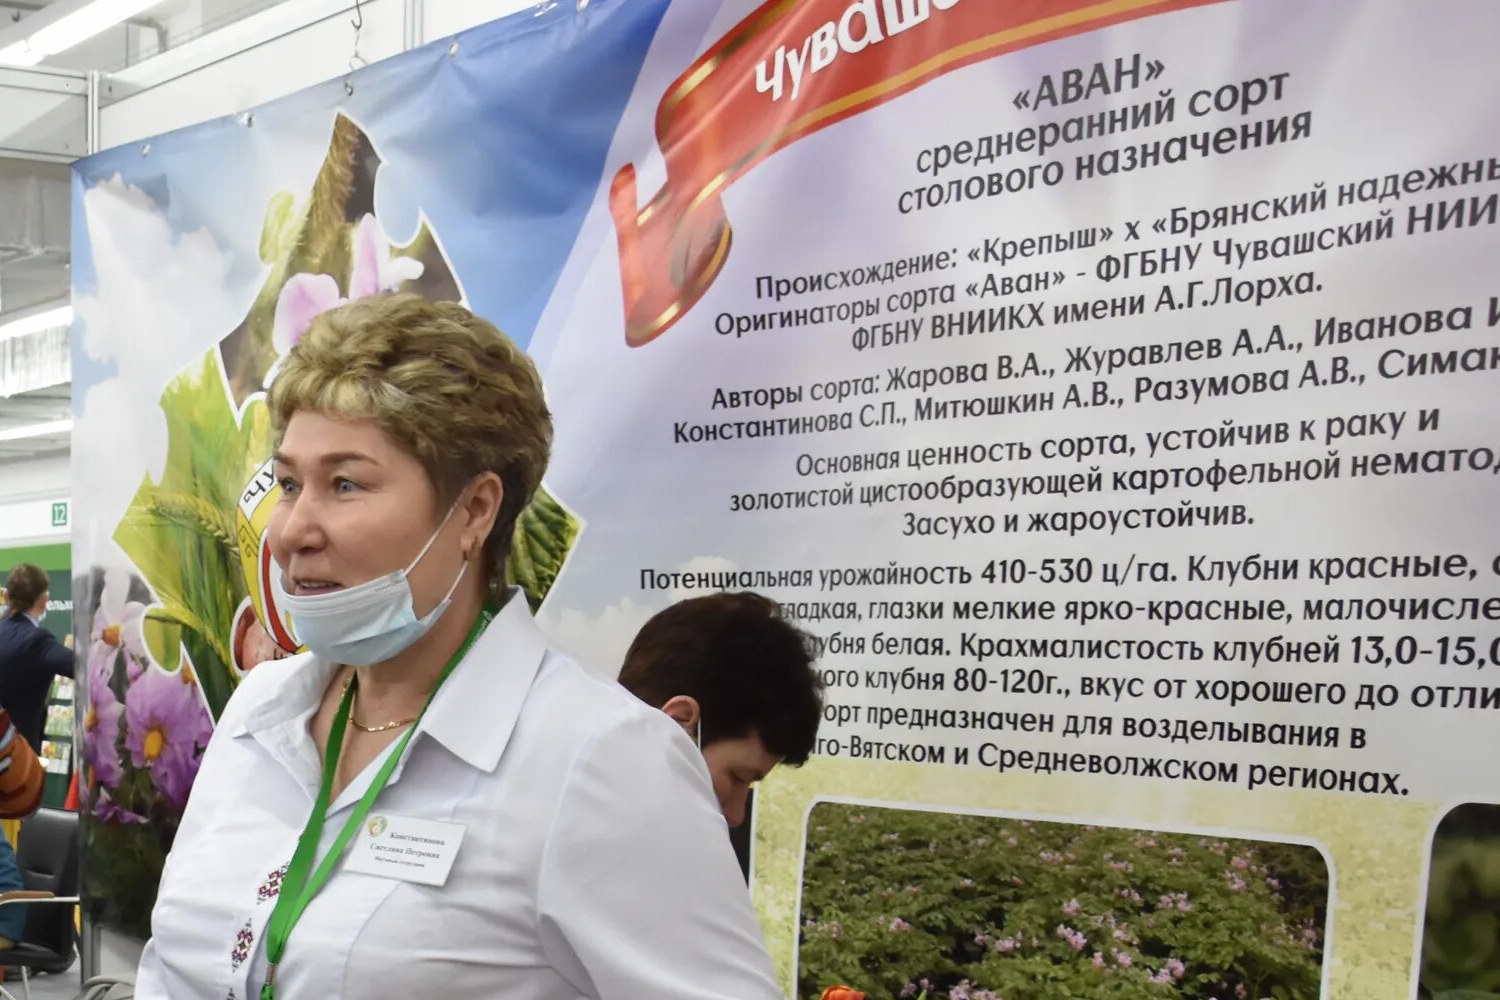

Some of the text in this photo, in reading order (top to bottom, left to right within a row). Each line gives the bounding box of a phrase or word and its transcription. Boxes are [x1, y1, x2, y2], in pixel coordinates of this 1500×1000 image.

[756, 0, 962, 101] Чуваш
[1012, 52, 1166, 112] «АВАН»
[916, 71, 1291, 177] среднеранний сорт
[897, 110, 1312, 215] столового назначения
[755, 247, 958, 303] Происхождение:
[967, 226, 1114, 267] «Крепыш»
[1151, 180, 1327, 239] «Брянский
[714, 297, 881, 339] Оригинаторы
[886, 284, 956, 314] сорта
[965, 270, 1066, 299] «Аван»
[1095, 242, 1203, 283] ФГБНУ
[1212, 208, 1395, 271] Чувашский
[851, 317, 925, 352] ФГБНУ
[930, 301, 1045, 340] ВНИИКХ
[1053, 294, 1146, 325] имени
[710, 385, 803, 411] Авторы
[809, 374, 880, 404] сорта:
[885, 362, 988, 393] Жарова
[1063, 337, 1223, 377] Журавлев
[1313, 306, 1473, 348] Иванова
[673, 411, 853, 444] Константинова
[914, 391, 1055, 422] Митюшкин
[1134, 368, 1290, 405] Разумова
[795, 408, 1440, 477] Основная ценность сорта, устойчив к раку и
[729, 447, 1500, 512] золотистой цистообразующей картофельной немато
[54, 505, 66, 524] 12
[902, 499, 1255, 541] Засухо и жароустойчив.
[640, 568, 814, 593] Потенциальная
[819, 560, 973, 592] урожайность
[980, 556, 1093, 585] 410-530
[1187, 552, 1299, 588] Клубни
[1308, 553, 1478, 586] красные,
[868, 600, 944, 620] глазки
[952, 600, 1056, 621] мелкие
[1063, 598, 1293, 627] ярко-красные,
[1302, 596, 1500, 621] малочисле
[871, 631, 952, 657] белая.
[960, 632, 1205, 663] Крахмалистость
[1213, 634, 1341, 669] клубней
[864, 666, 946, 695] клубня
[1080, 676, 1145, 703] вкус
[1153, 677, 1188, 699] от
[1194, 679, 1347, 708] хорошего
[1354, 683, 1400, 711] до
[823, 702, 1367, 750] орт предназначен для возделывания в
[953, 746, 969, 766] и
[977, 742, 1239, 784] Средневолжском
[1247, 763, 1410, 797] регионах.
